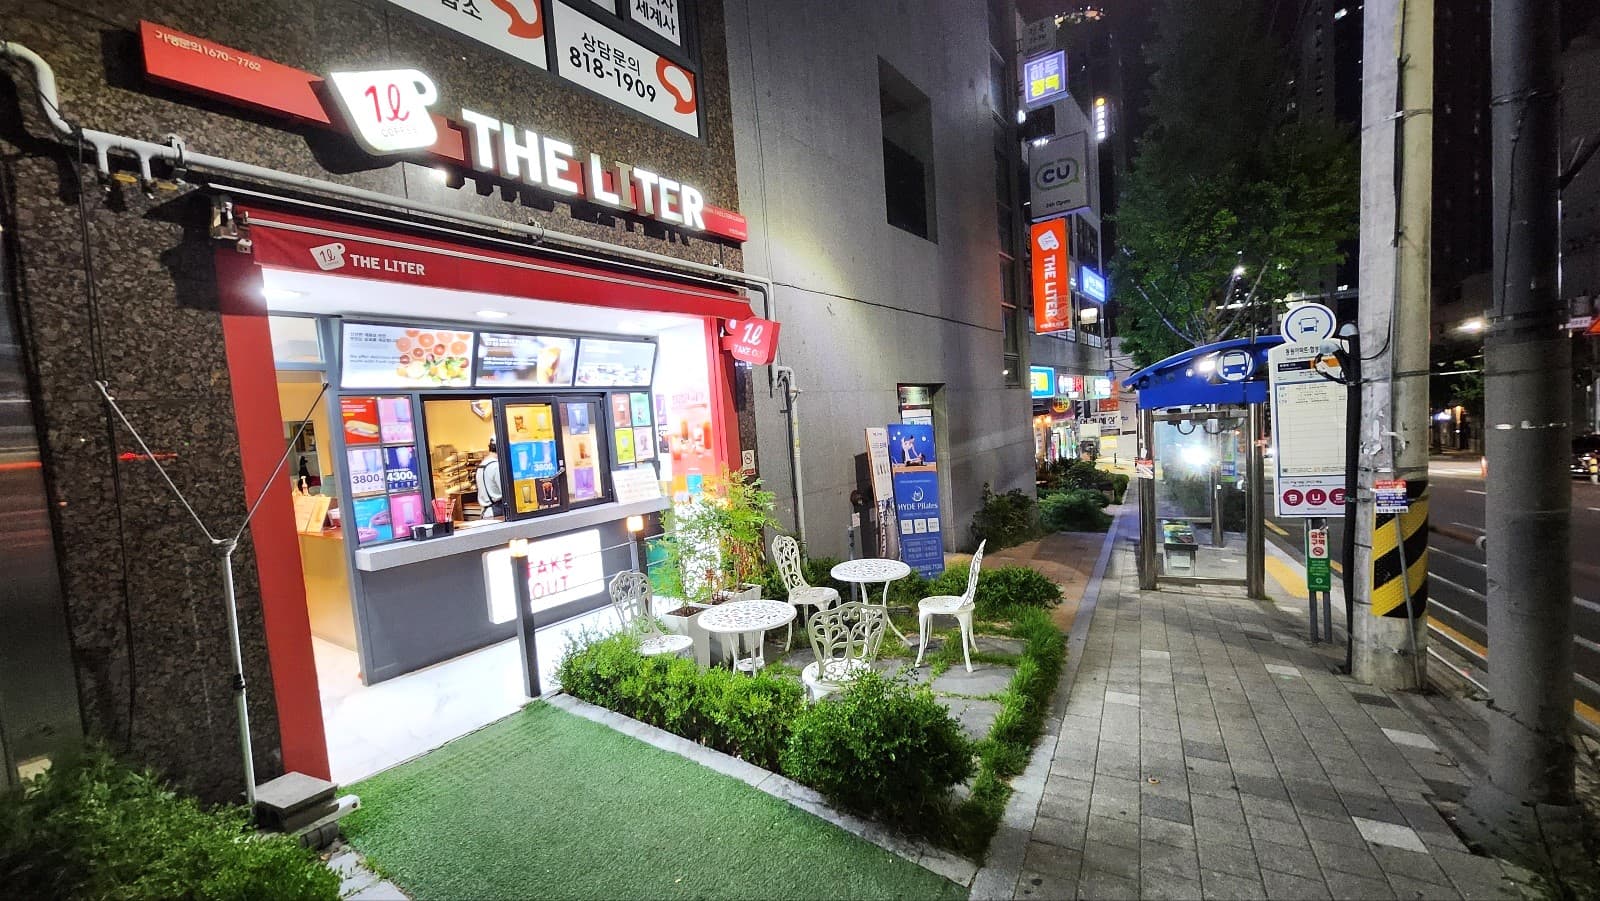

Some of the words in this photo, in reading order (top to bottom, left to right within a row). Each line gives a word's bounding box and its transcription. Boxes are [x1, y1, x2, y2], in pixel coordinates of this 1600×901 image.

[582, 32, 642, 76] 상담문의
[569, 46, 657, 103] 818-1909
[460, 108, 579, 195] THE
[589, 153, 707, 231] LITER
[1042, 164, 1070, 184] CU
[350, 253, 381, 269] THE
[384, 258, 425, 276] LITER
[1043, 254, 1056, 280] THE
[1045, 281, 1058, 317] LITER
[353, 473, 380, 484] 3800
[387, 471, 413, 481] 4300
[898, 503, 916, 511] HYDE
[527, 552, 573, 578] TAKE
[532, 575, 569, 599] OUT
